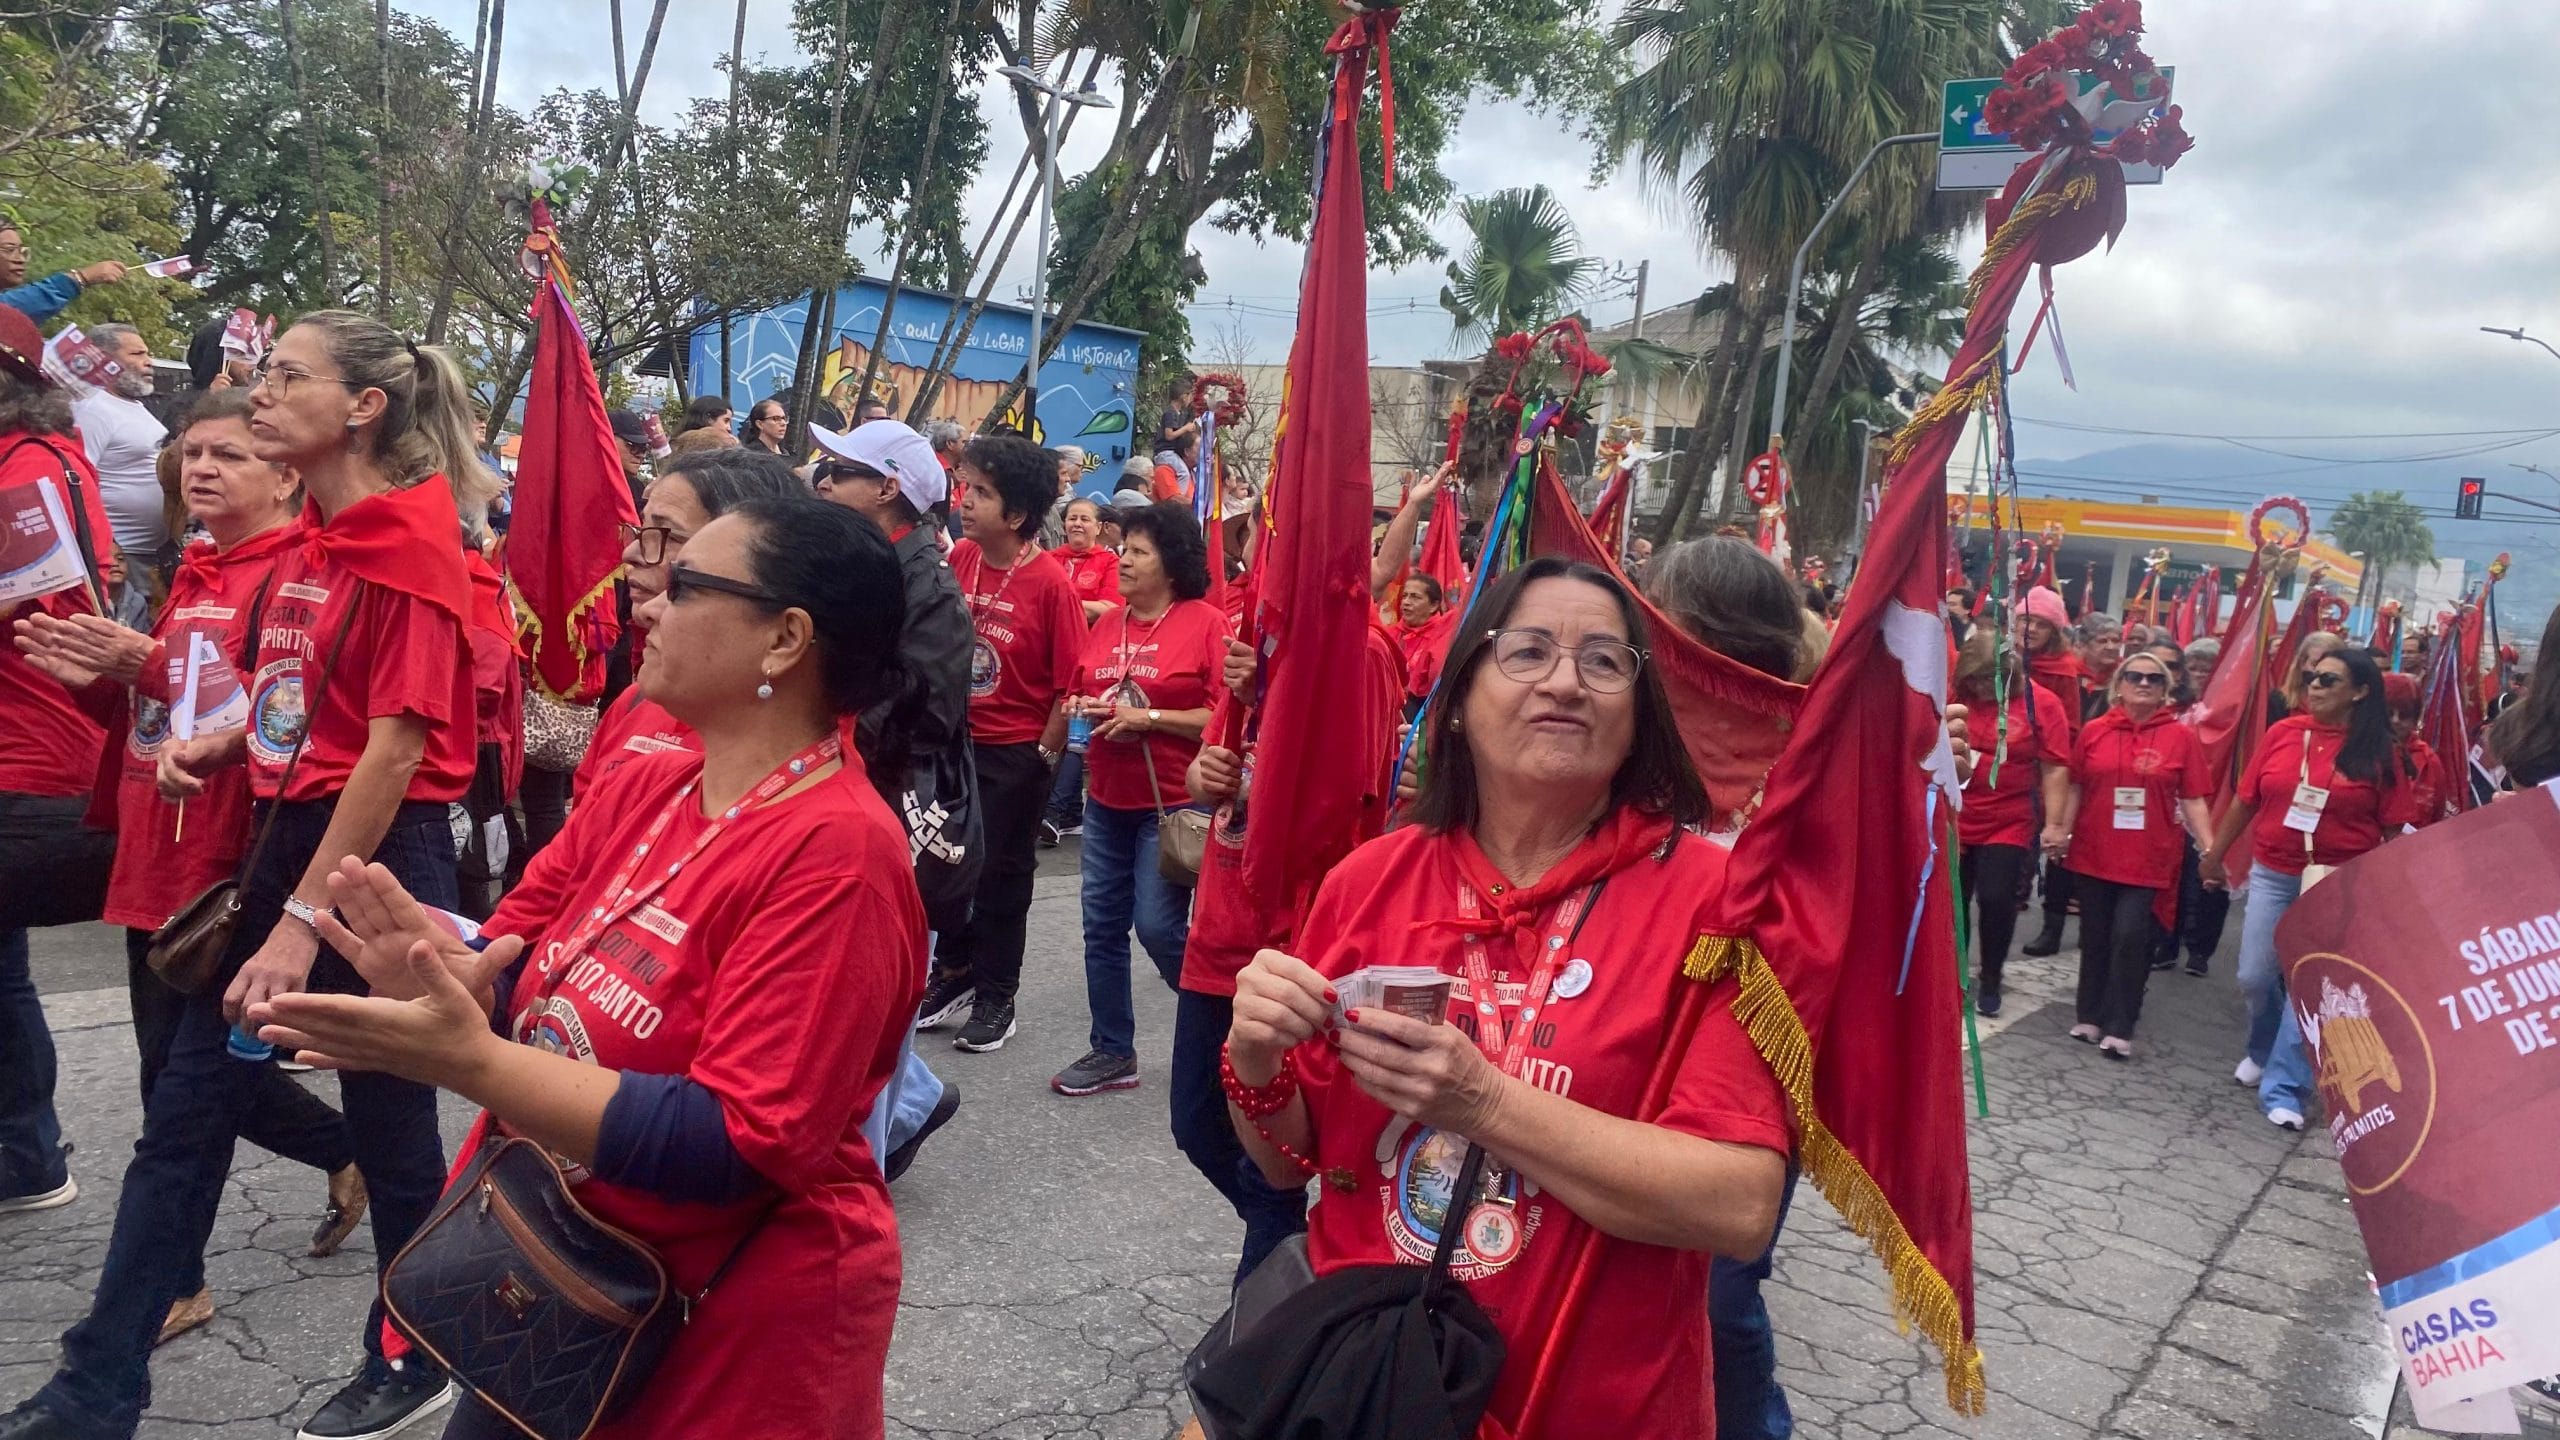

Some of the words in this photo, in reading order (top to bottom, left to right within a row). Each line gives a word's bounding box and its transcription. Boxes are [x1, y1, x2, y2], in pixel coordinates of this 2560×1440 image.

[987, 622, 1015, 644] SANTO
[1130, 664, 1159, 679] SANTO
[2459, 909, 2560, 976] SÁBAD
[1498, 971, 1509, 982] DE
[2438, 995, 2462, 1031] 7
[2461, 978, 2513, 1023] DE
[2506, 957, 2560, 1009] JUN
[588, 973, 663, 1040] SANTO
[570, 1021, 591, 1057] SANTO
[2504, 1011, 2557, 1056] DE
[1521, 1056, 1573, 1099] NTO
[1392, 1221, 1404, 1238] SÃO
[1522, 1205, 1543, 1249] CRIAÇÃO
[2402, 1298, 2498, 1355] CASAS
[2411, 1335, 2506, 1388] BAHIA
